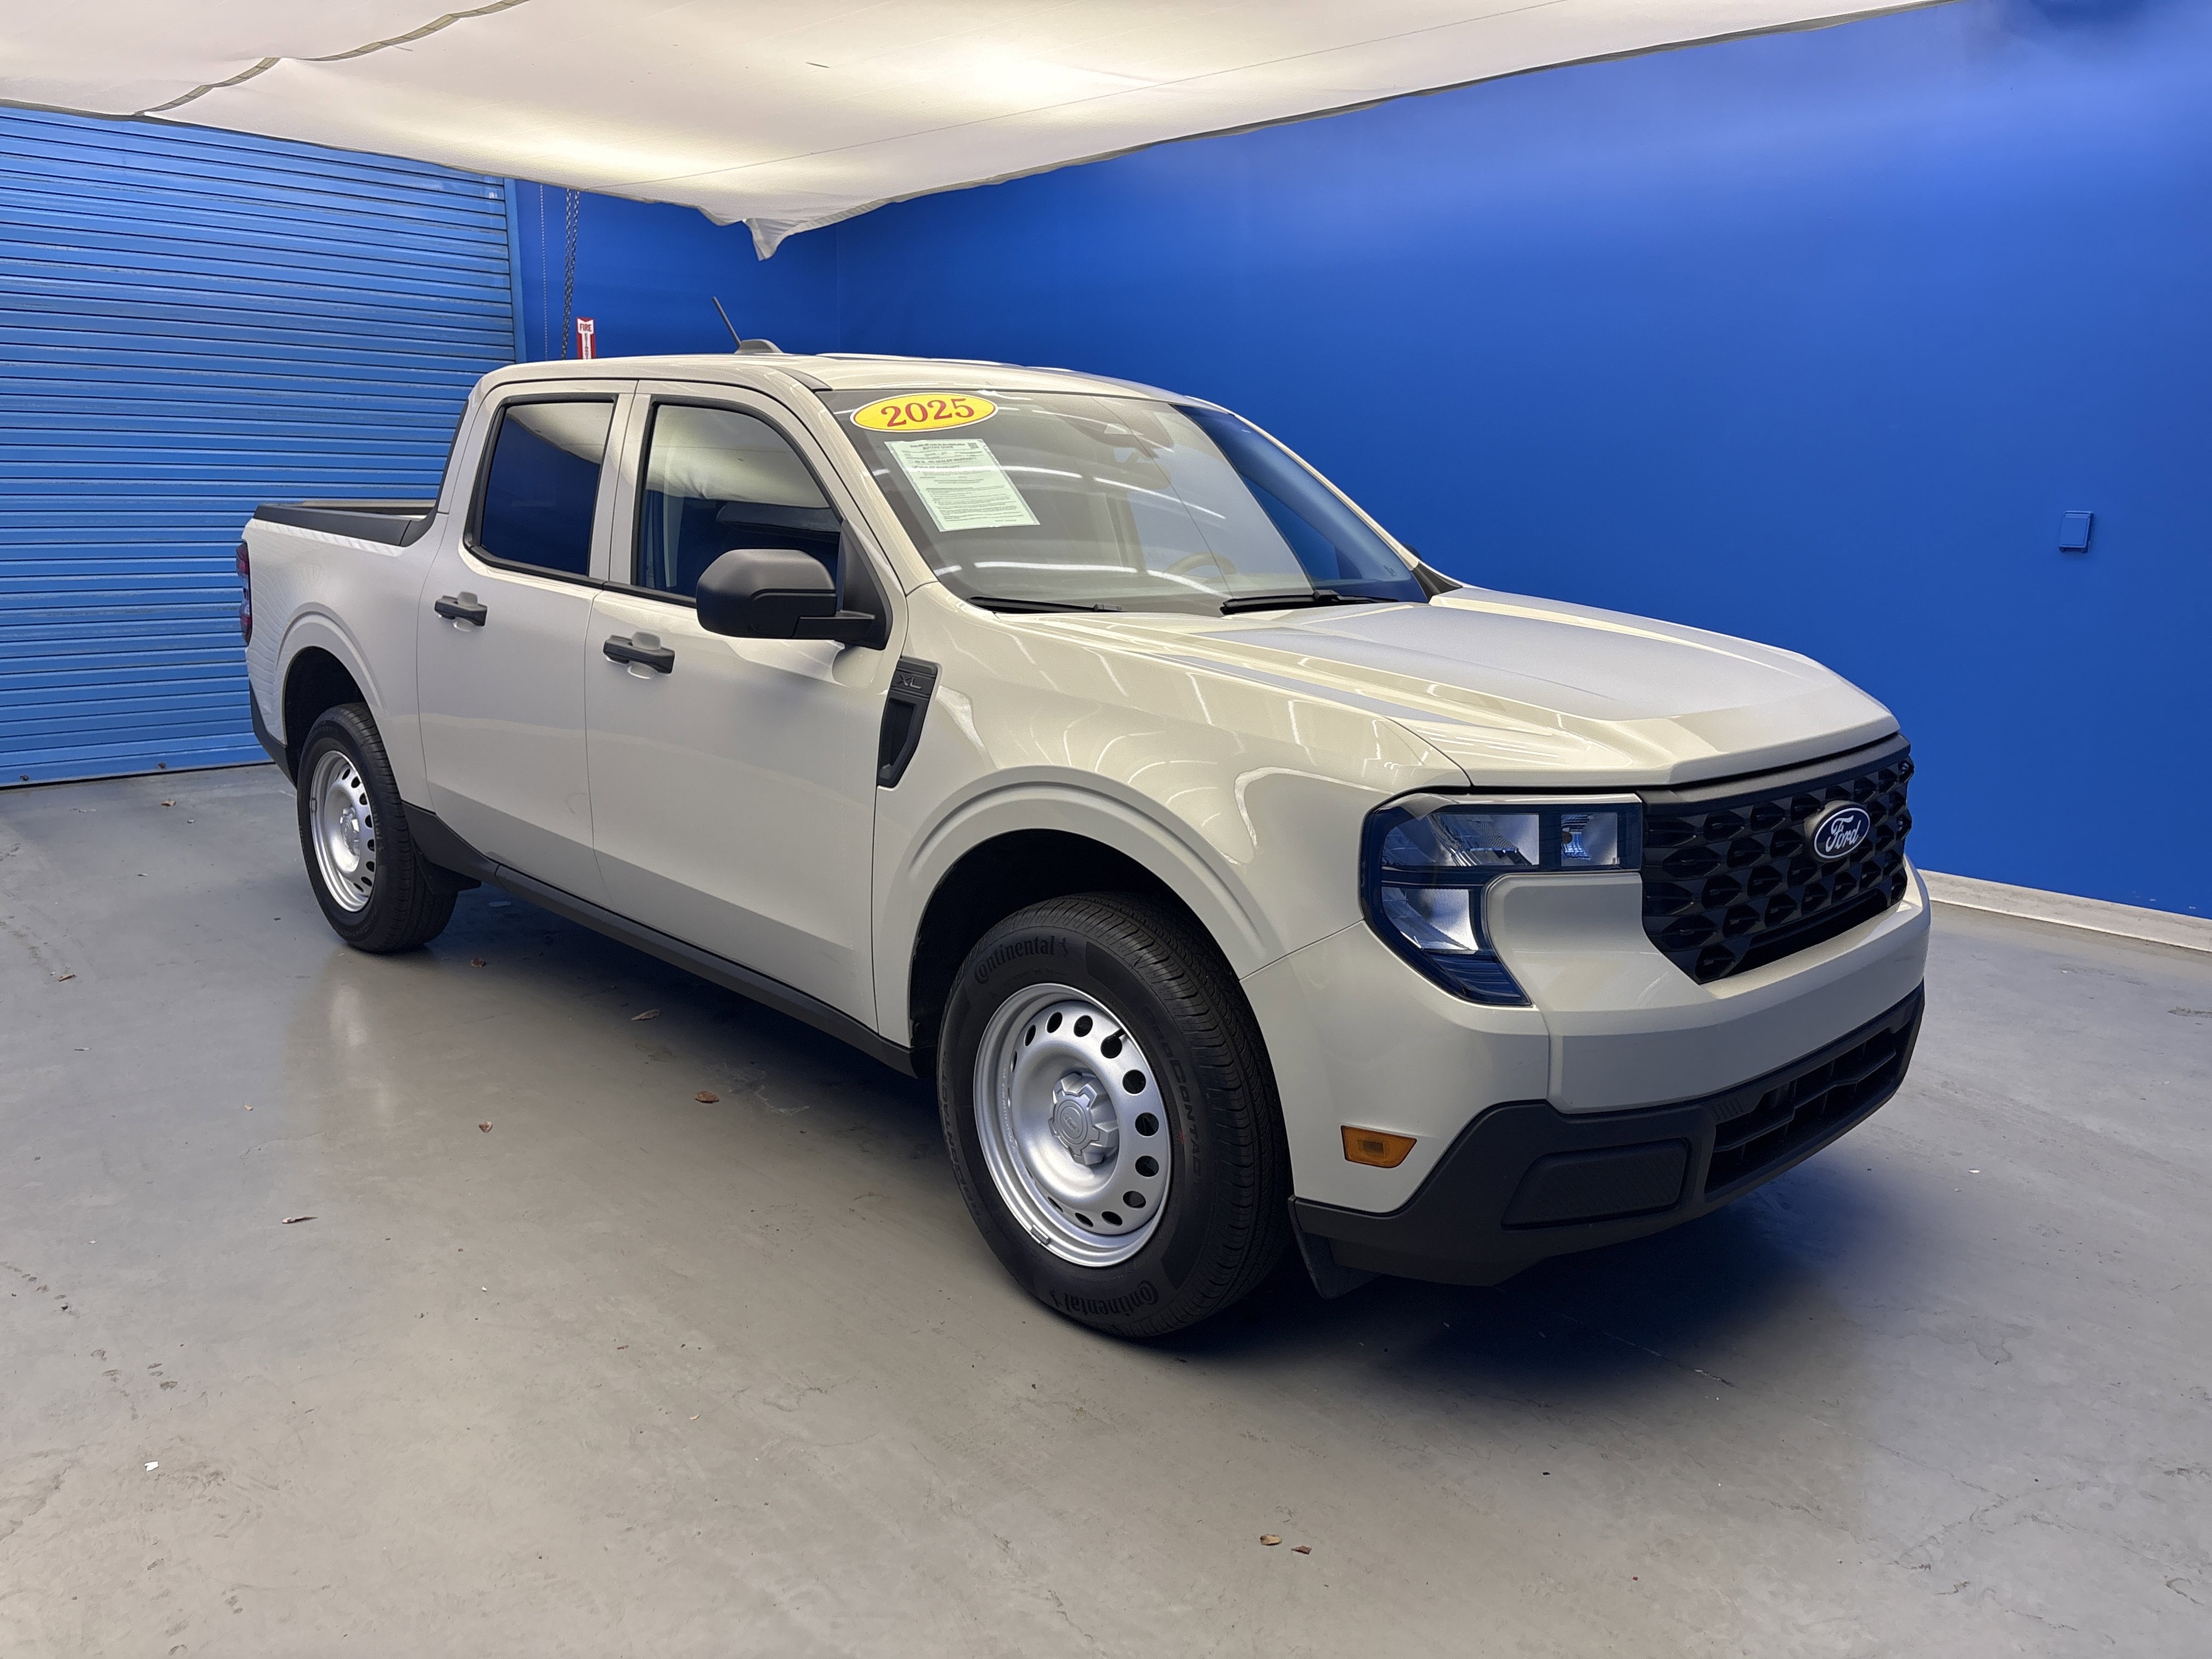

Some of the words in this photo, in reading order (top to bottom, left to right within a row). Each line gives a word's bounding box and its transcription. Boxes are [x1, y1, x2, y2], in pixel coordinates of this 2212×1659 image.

[580, 323, 591, 331] FIRE
[881, 398, 974, 427] 2025
[896, 675, 922, 689] XL
[1825, 815, 1861, 852] Ford
[974, 935, 1055, 984] Continental
[1064, 1279, 1159, 1317] Continental
